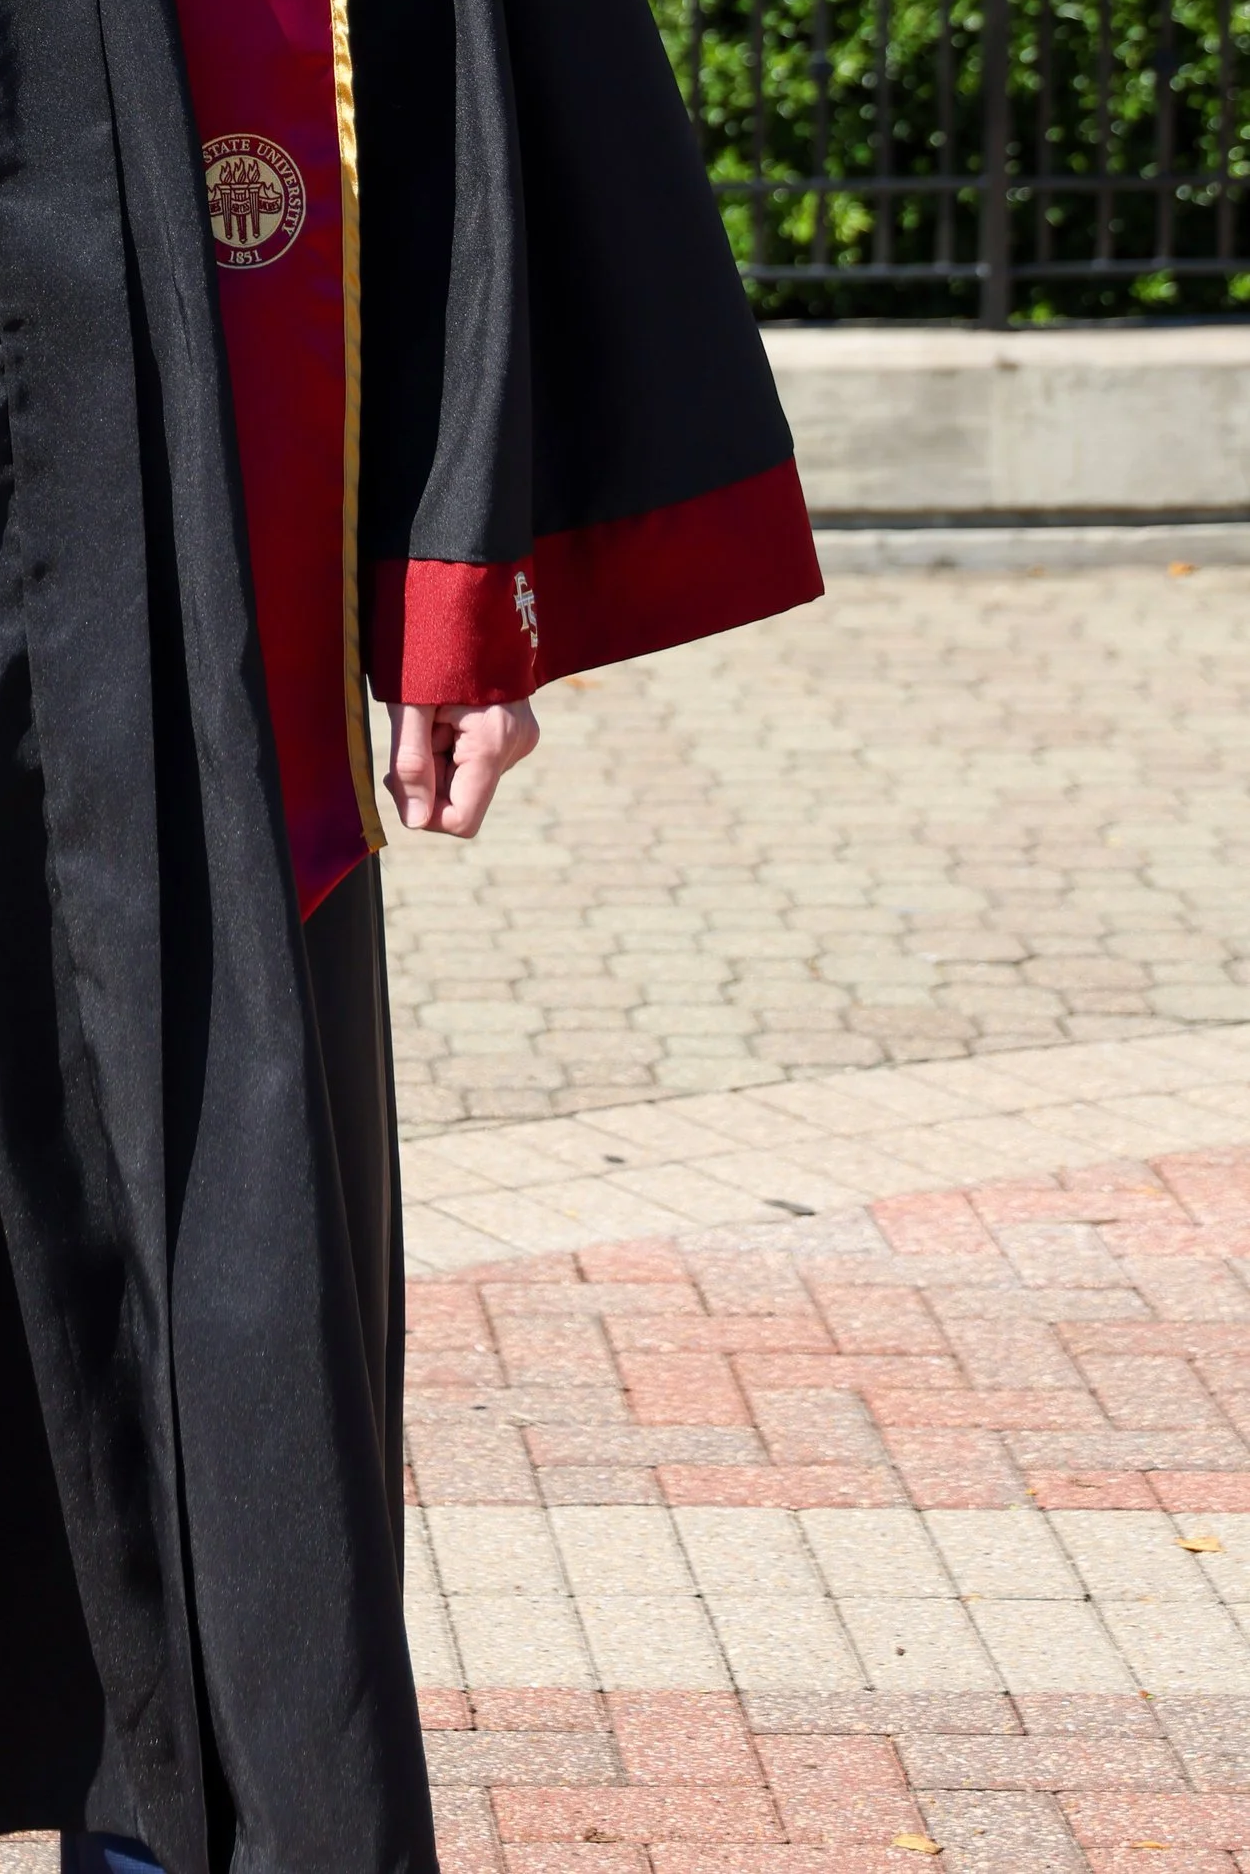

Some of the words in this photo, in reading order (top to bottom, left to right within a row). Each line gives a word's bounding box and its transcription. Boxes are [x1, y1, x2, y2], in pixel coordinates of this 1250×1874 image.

[203, 139, 251, 164] STATE
[257, 143, 302, 236] UNIVERSITY
[228, 250, 263, 265] 1851
